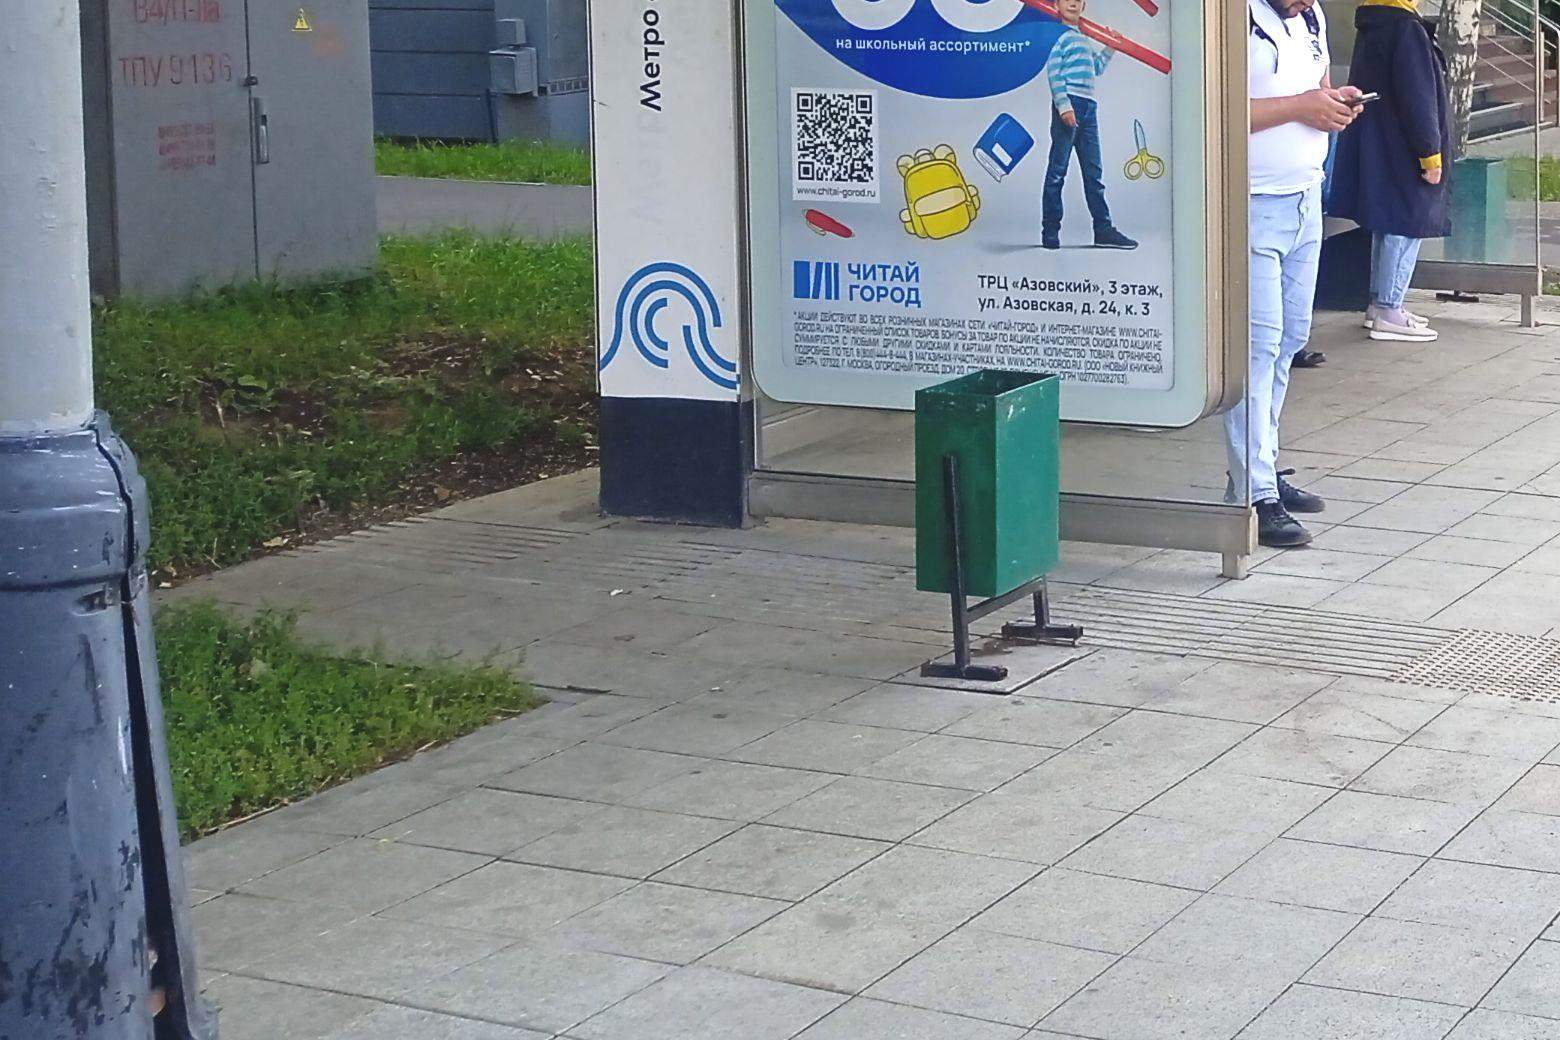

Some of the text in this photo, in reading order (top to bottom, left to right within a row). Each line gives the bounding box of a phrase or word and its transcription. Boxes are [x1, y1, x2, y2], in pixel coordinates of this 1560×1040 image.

[836, 38, 853, 50] на
[856, 36, 926, 53] школьный
[640, 8, 667, 112] Метро
[797, 186, 876, 199] www.chitai-gorod.ru
[847, 261, 920, 283] ЧИТАЙ
[849, 284, 922, 308] ГОРОД
[977, 274, 1163, 298] ТРЦ «Азовский», 3 этаж,
[977, 296, 1150, 317] ул. Азовская, д. 24, к. 3
